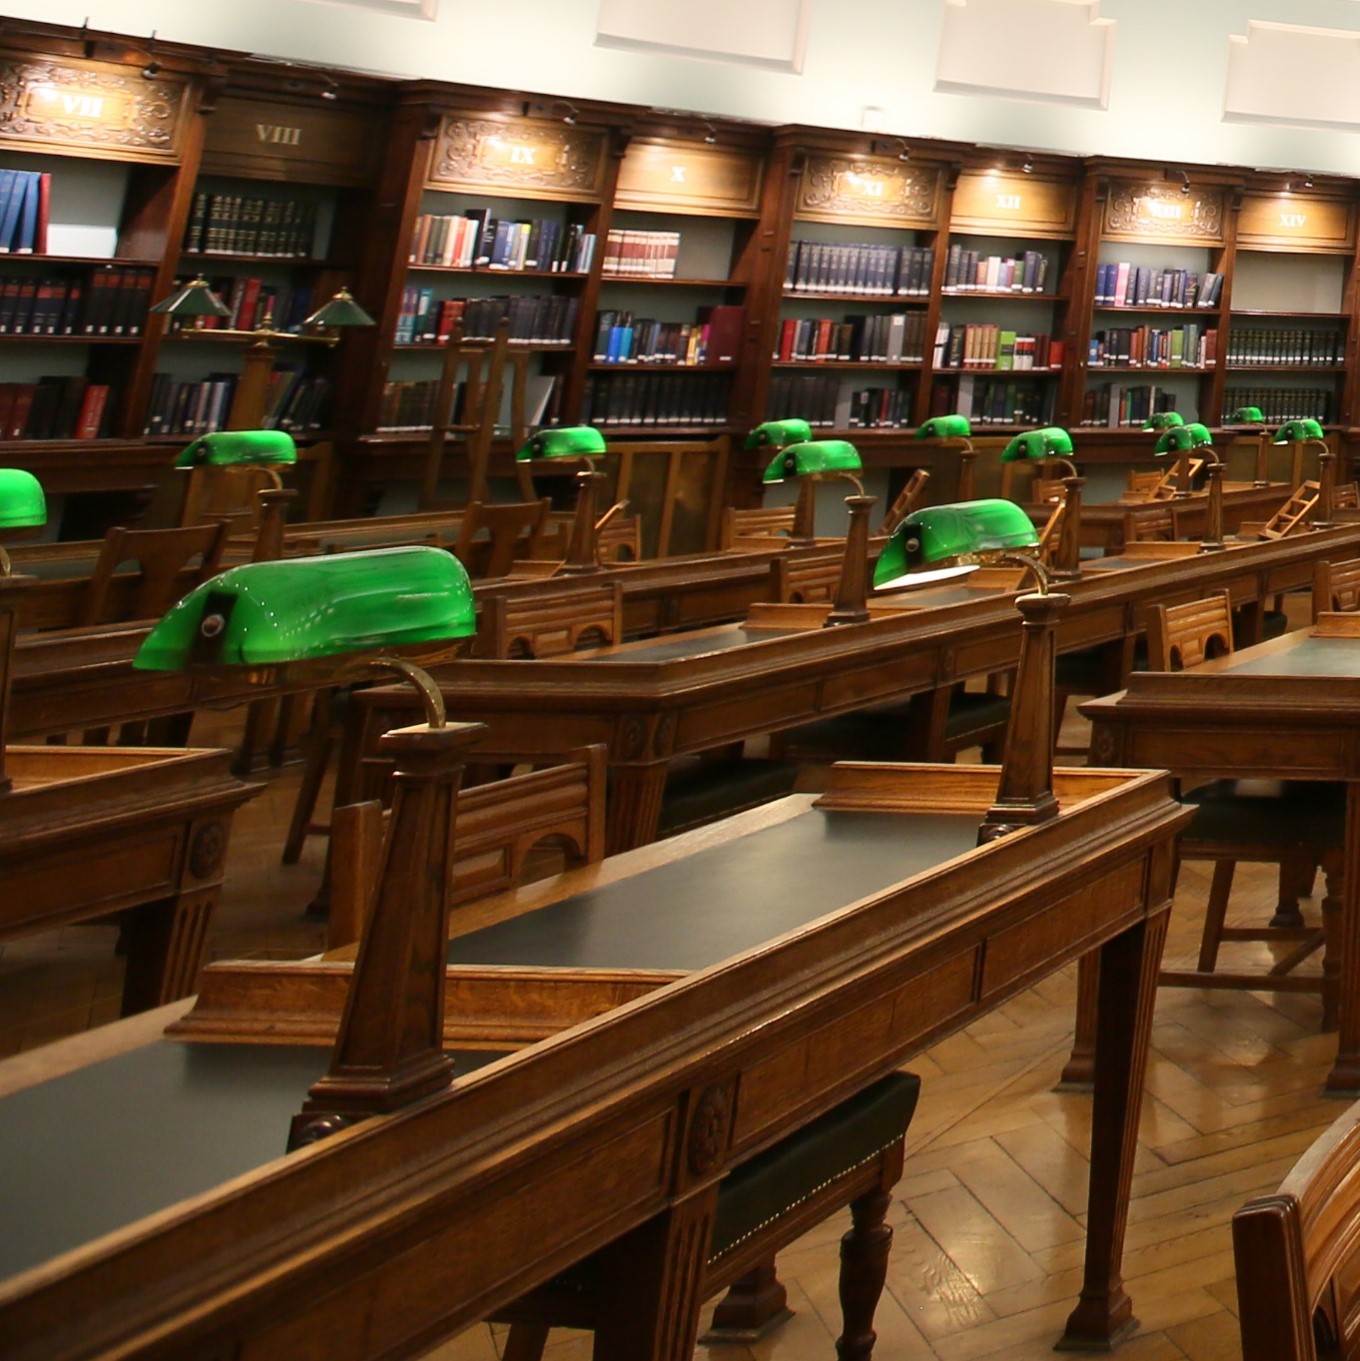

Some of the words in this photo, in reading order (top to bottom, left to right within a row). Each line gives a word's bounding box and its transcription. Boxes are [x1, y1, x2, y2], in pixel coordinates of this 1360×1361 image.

[62, 95, 103, 118] VII
[256, 124, 302, 145] VIII
[511, 147, 537, 164] IX
[671, 167, 684, 182] X
[862, 181, 883, 196] XI
[996, 194, 1021, 210] XII
[1279, 214, 1306, 227] XIV
